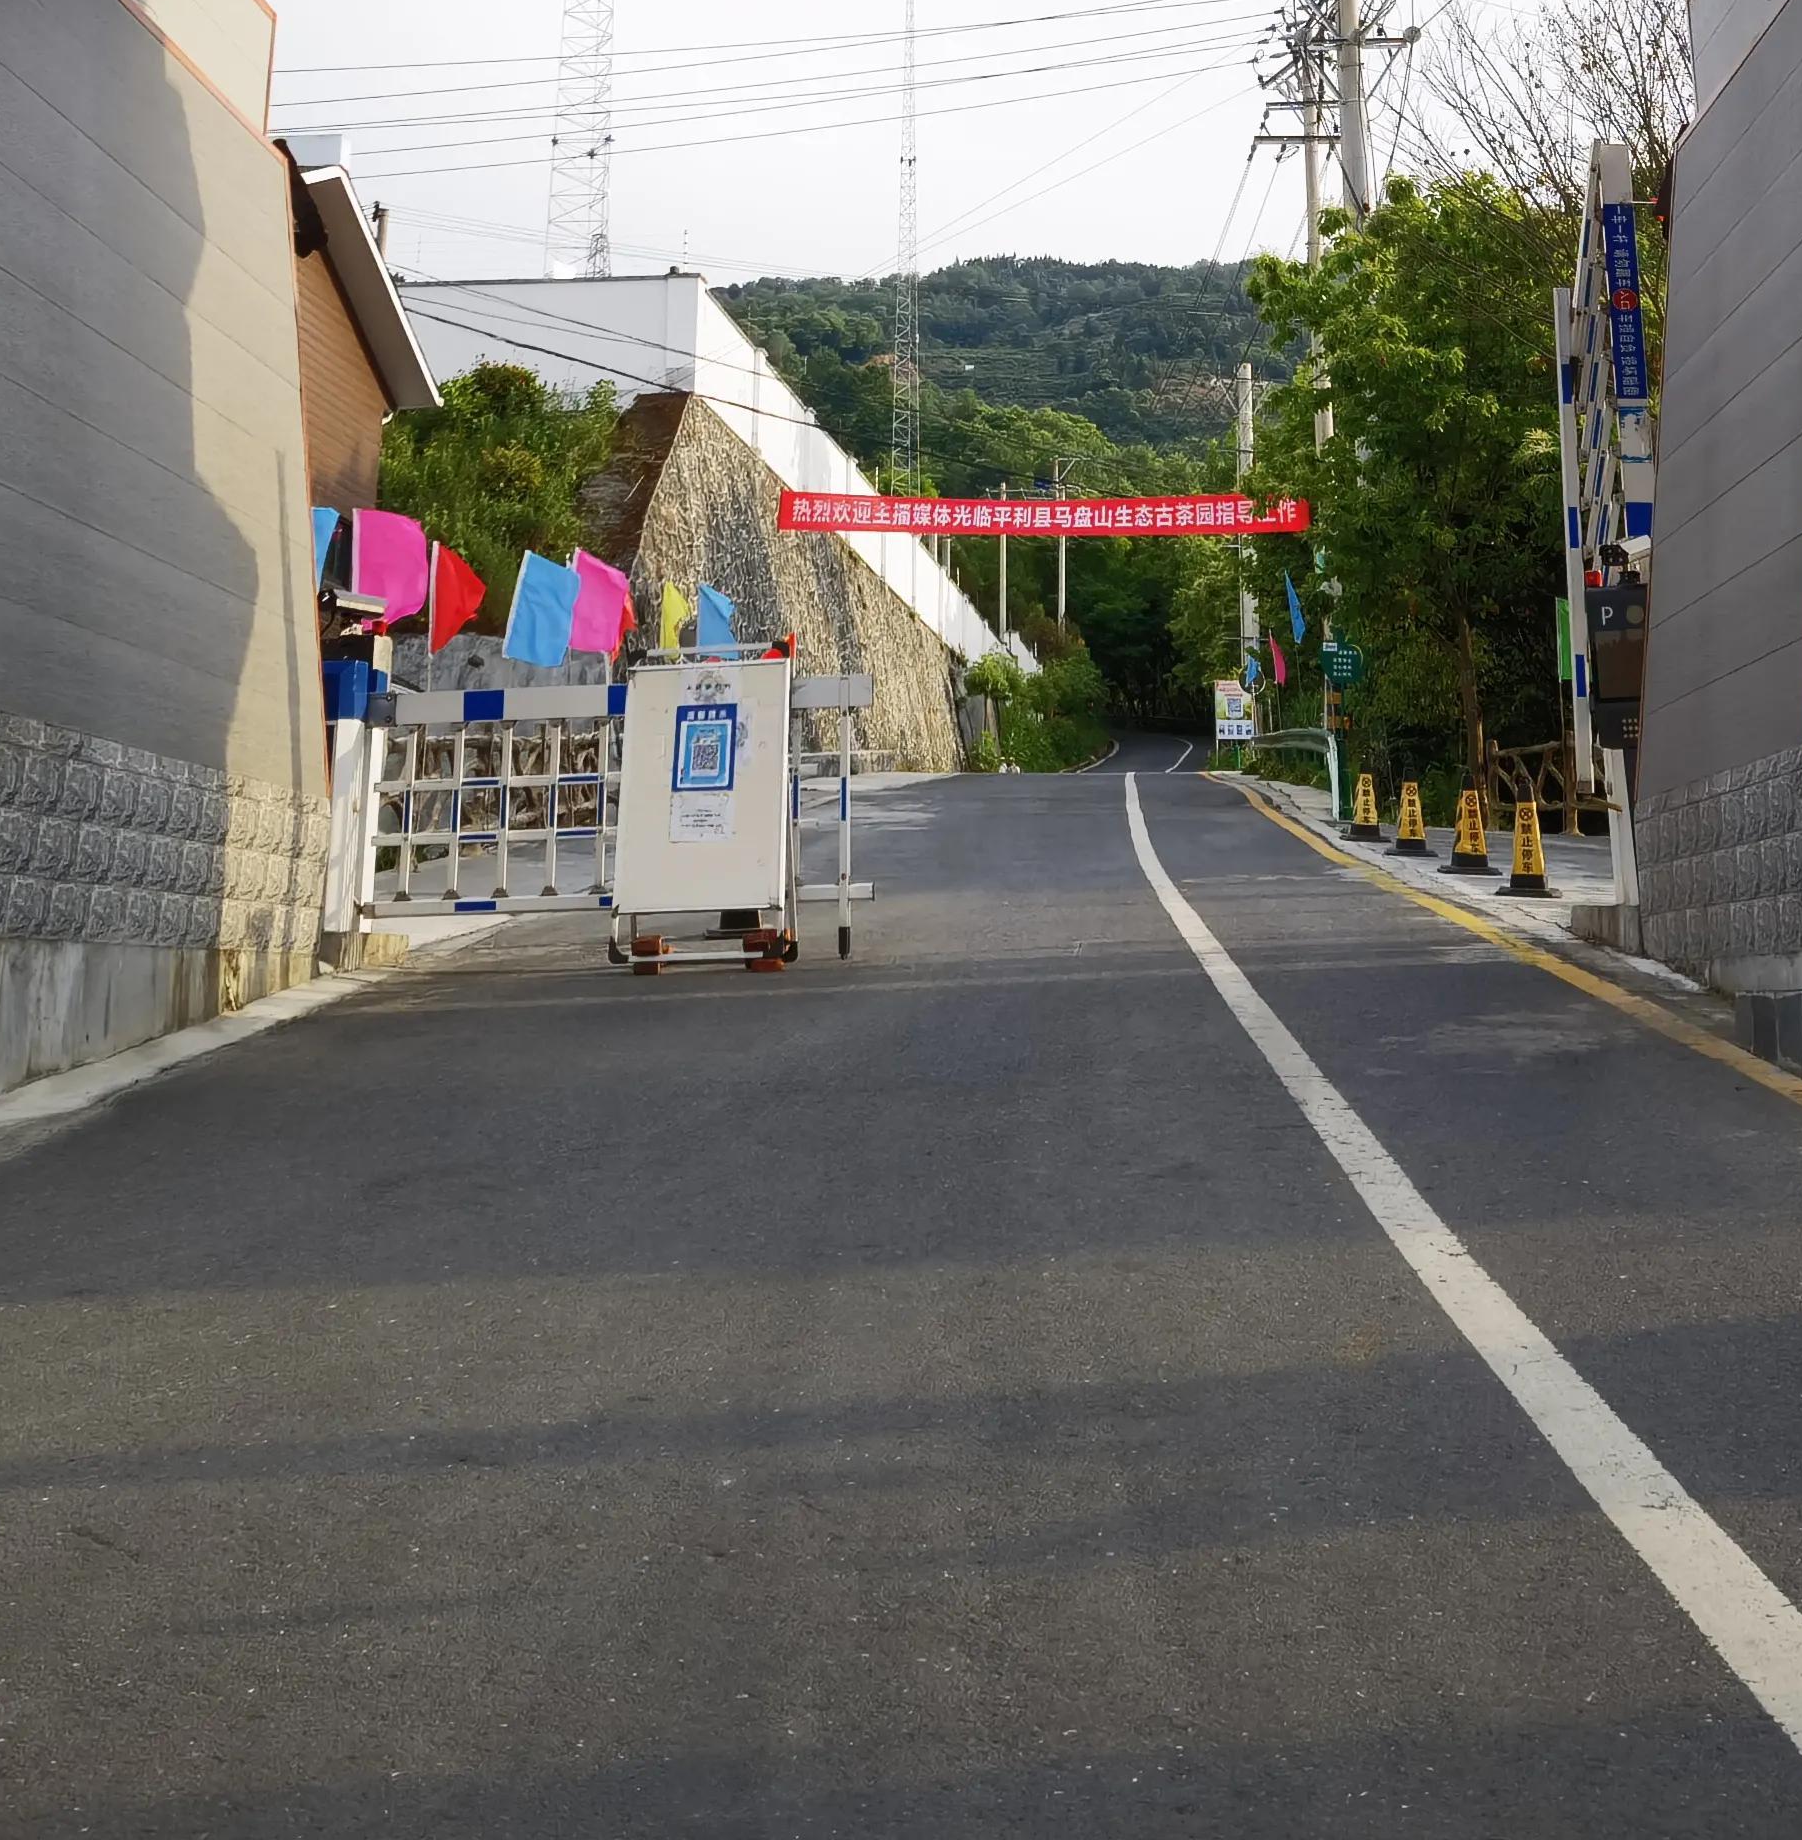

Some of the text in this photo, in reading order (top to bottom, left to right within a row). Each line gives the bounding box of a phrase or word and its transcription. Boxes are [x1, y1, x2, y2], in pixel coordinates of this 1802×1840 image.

[1601, 606, 1614, 626] P
[1520, 822, 1534, 875] 禁止停车
